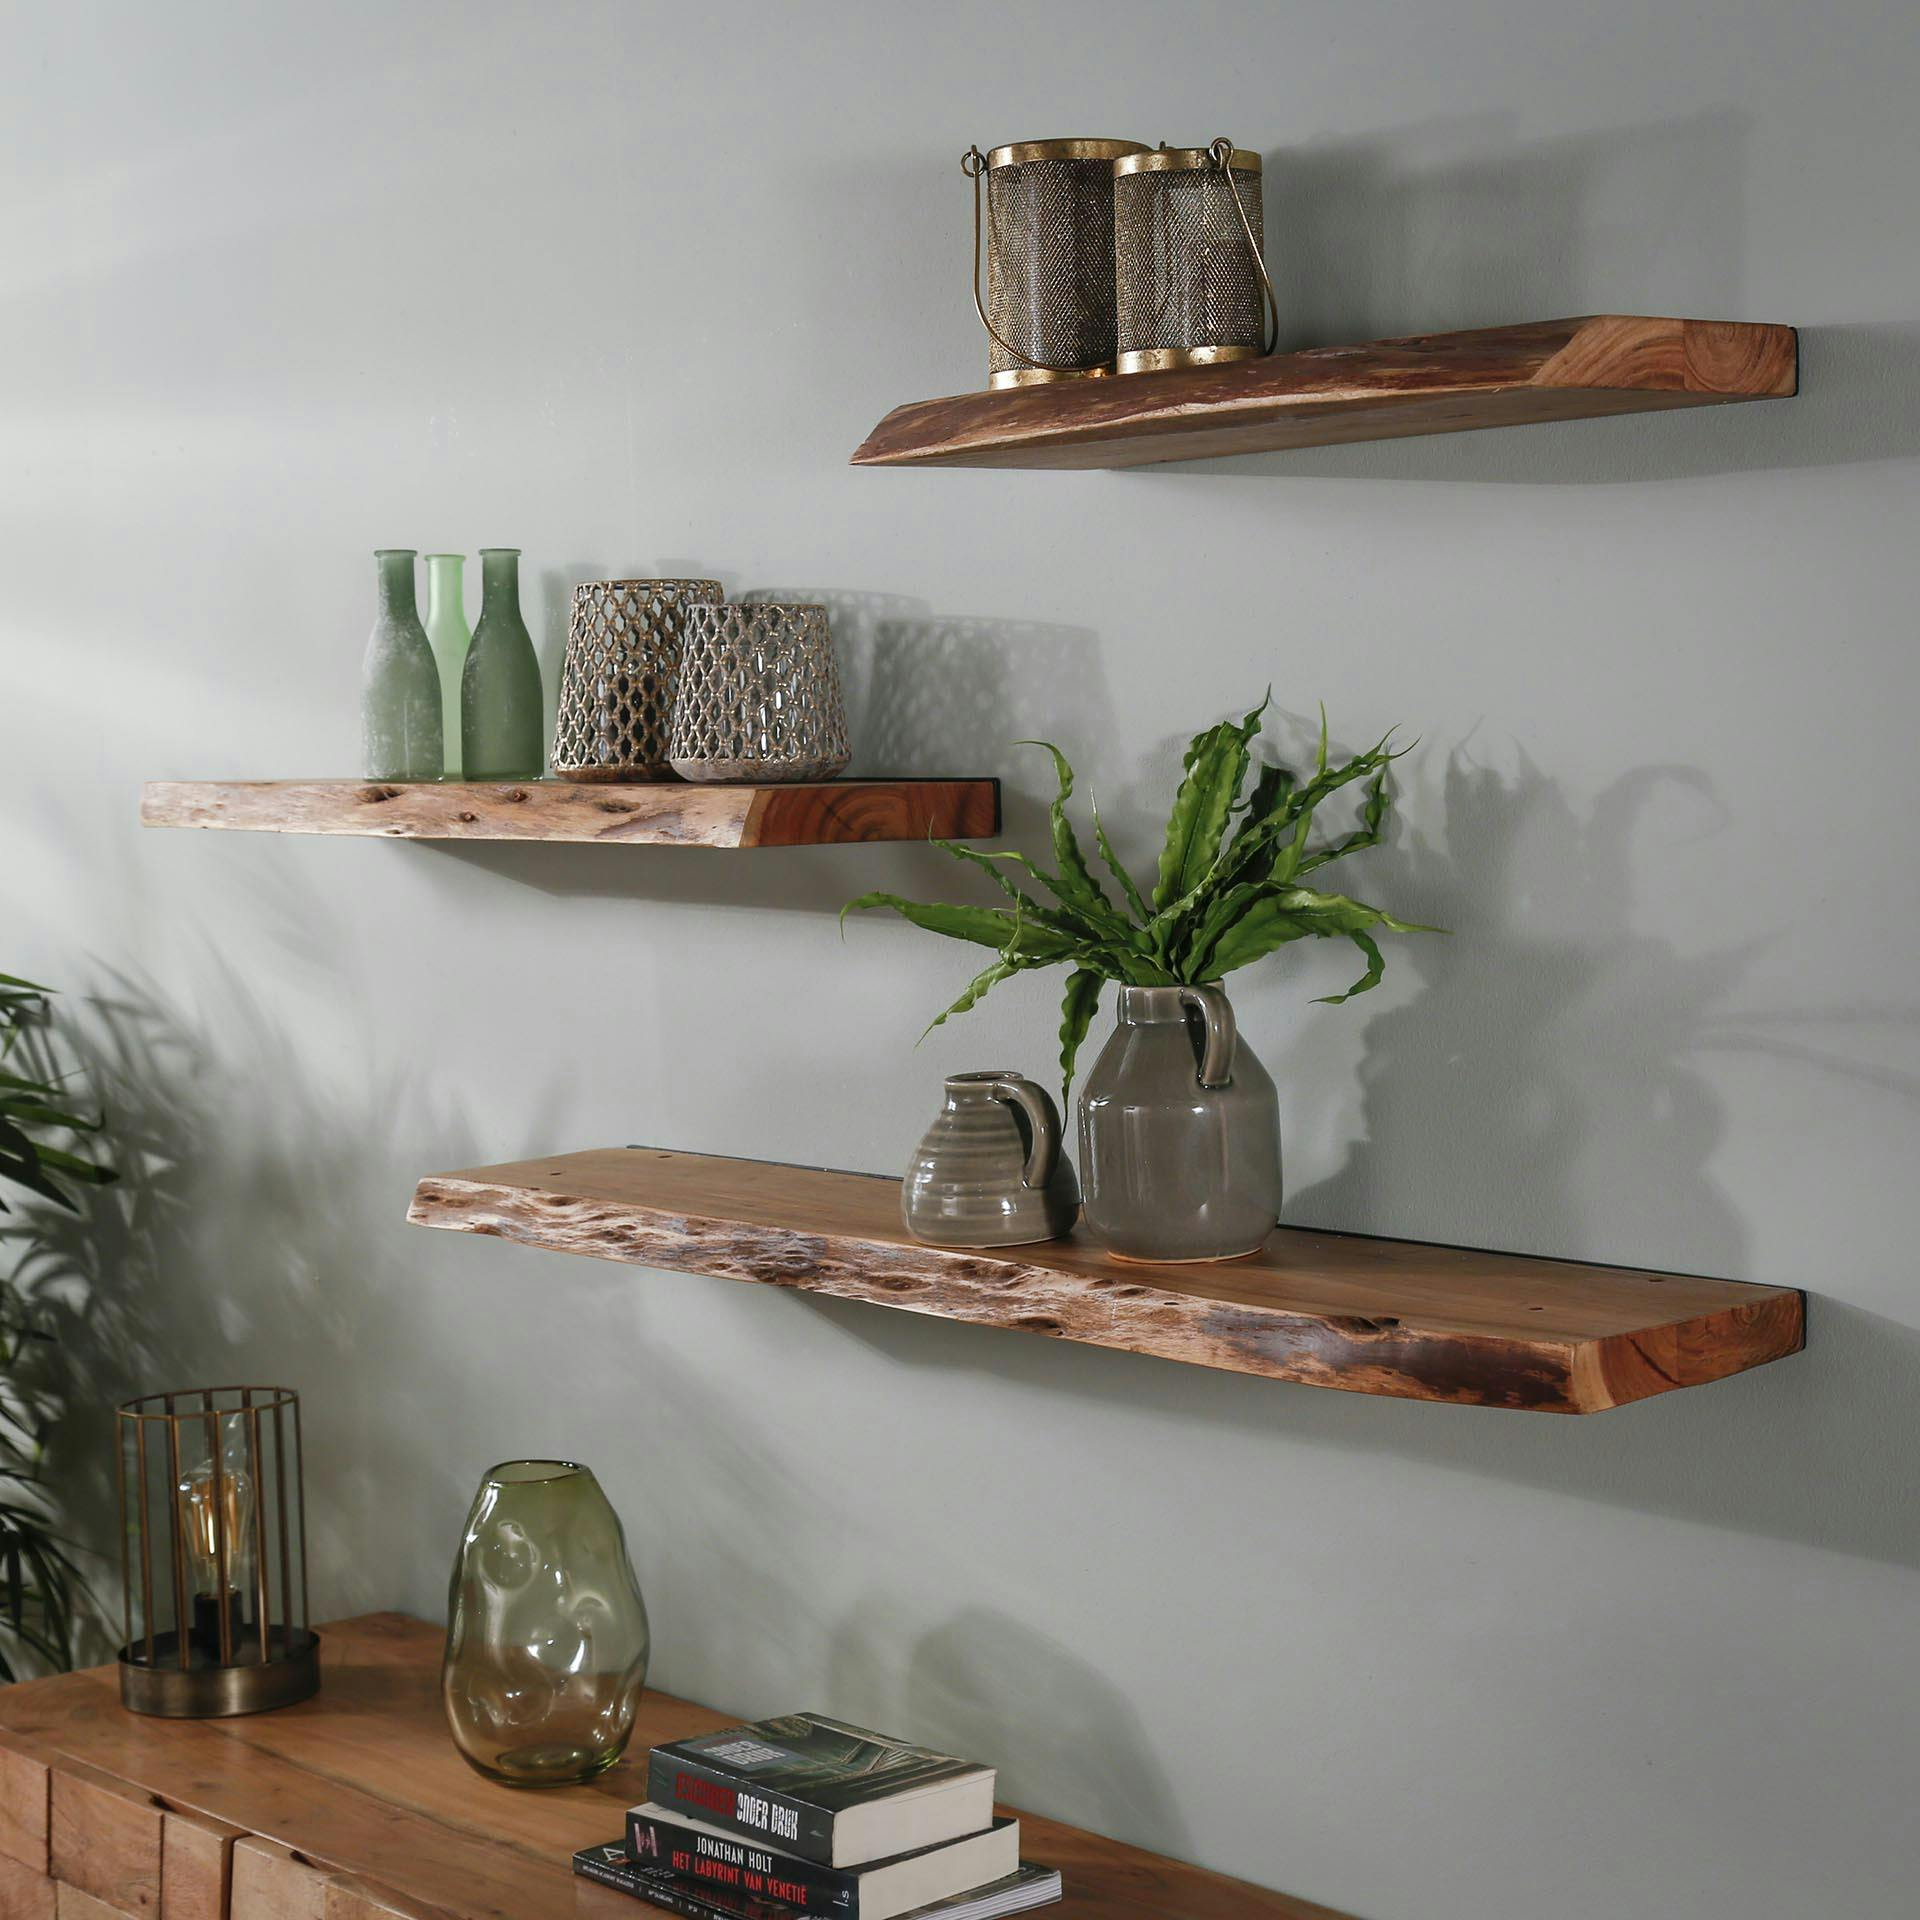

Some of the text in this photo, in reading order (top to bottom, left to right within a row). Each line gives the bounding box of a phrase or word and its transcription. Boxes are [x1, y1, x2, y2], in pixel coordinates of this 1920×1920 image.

[771, 1803, 799, 1841] DRUK
[672, 1850, 691, 1871] HET
[694, 1854, 741, 1886] LABYRINT
[744, 1871, 763, 1892] VAN
[696, 1836, 773, 1874] JONATHAN HOLT
